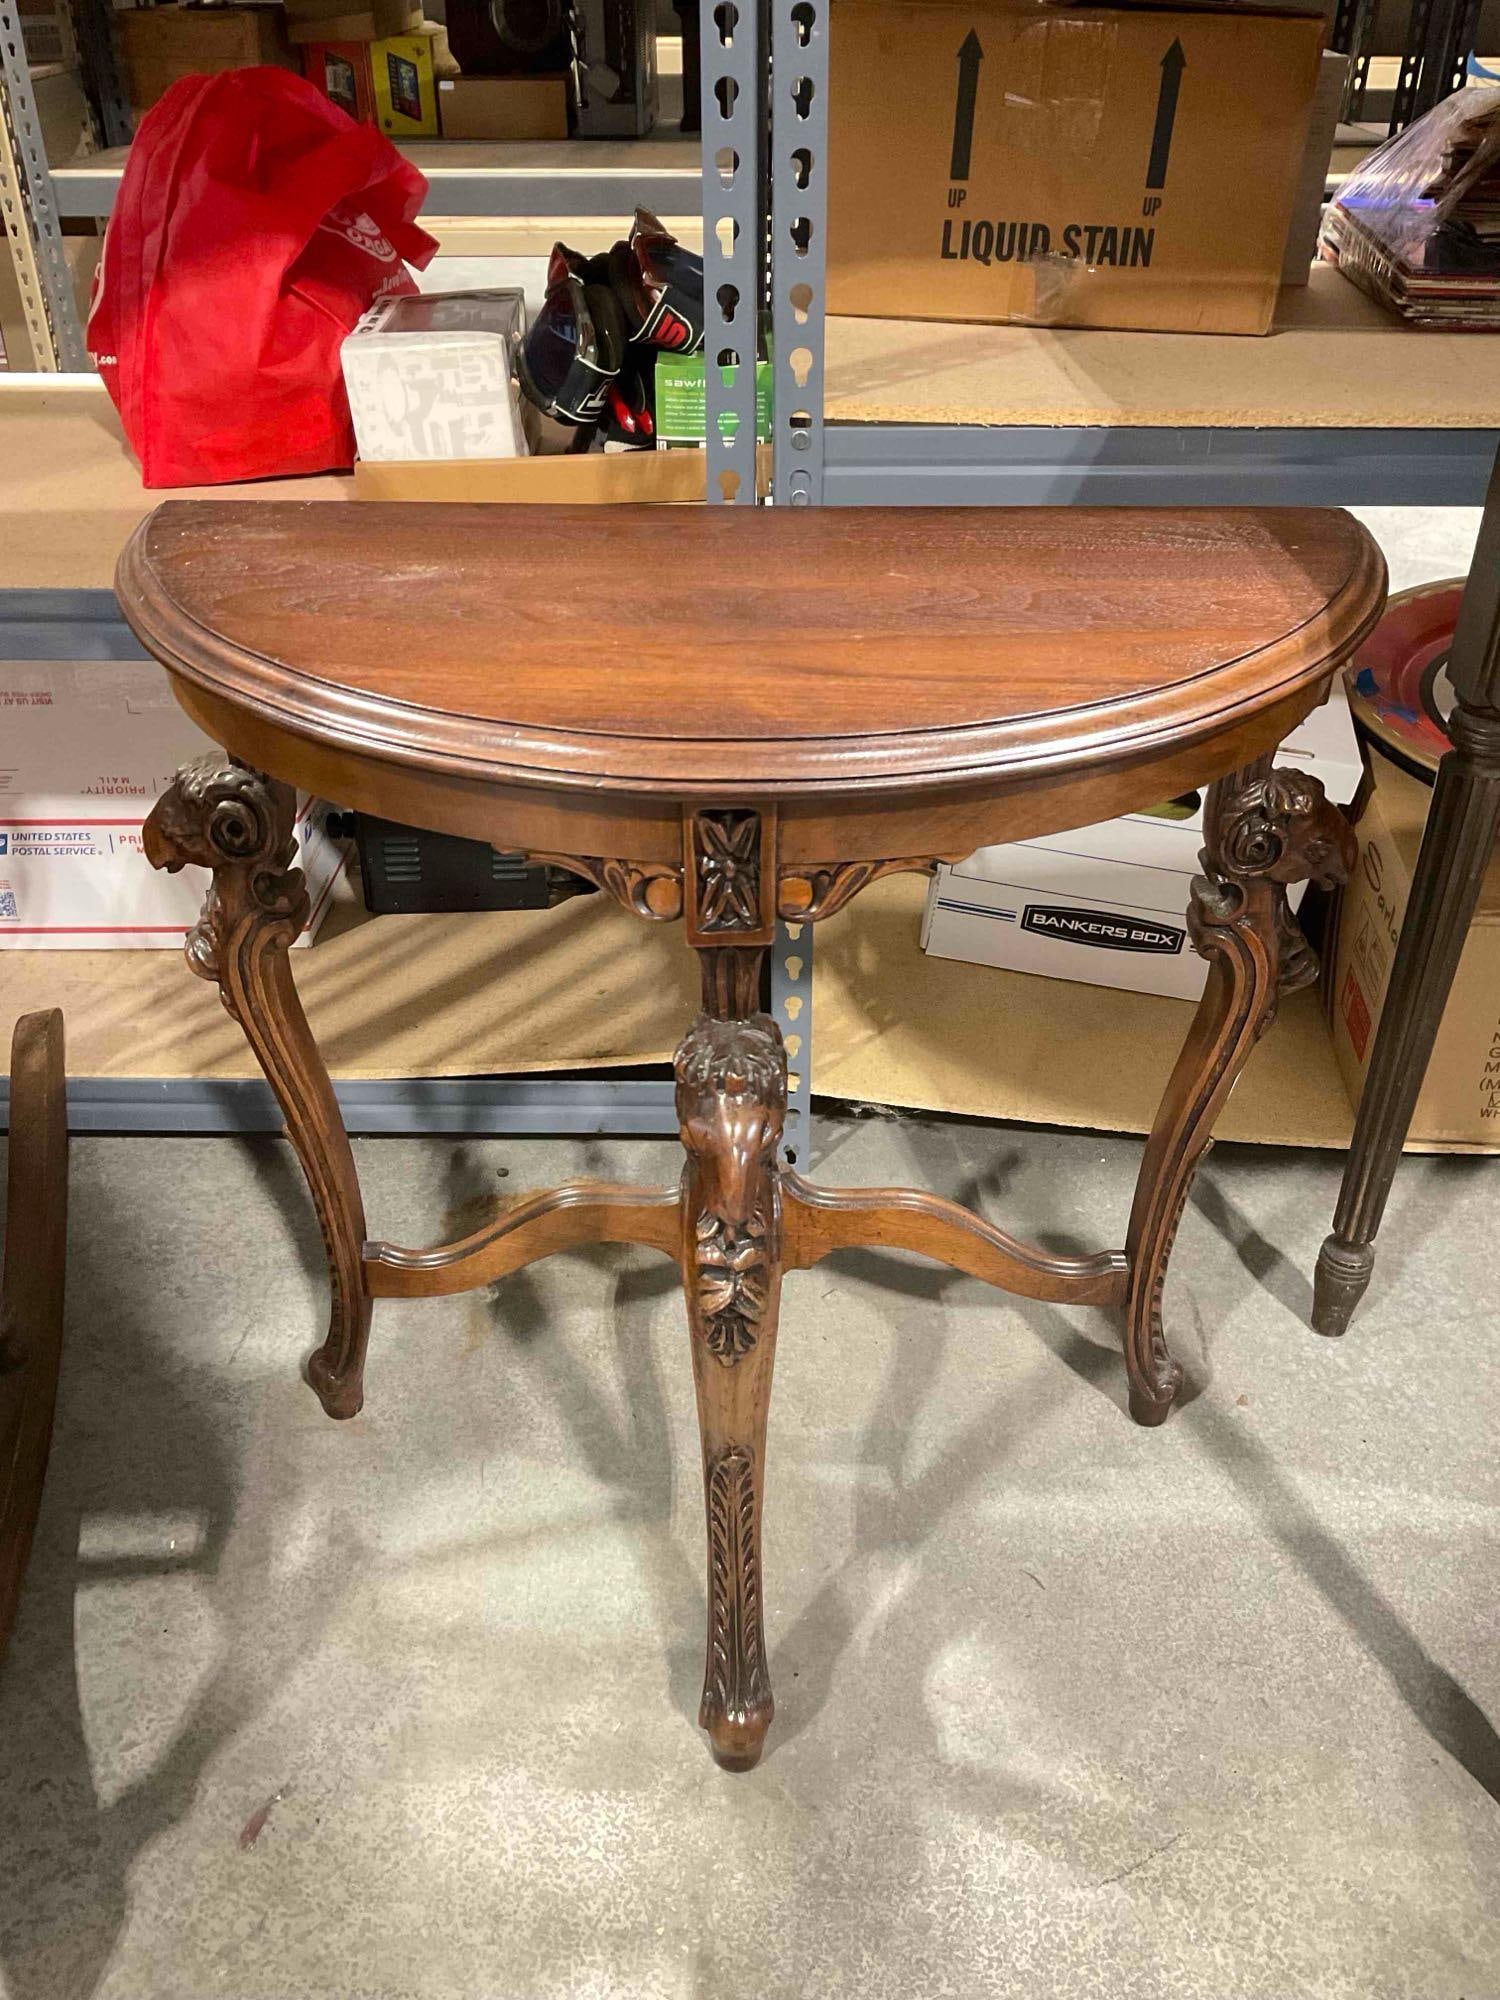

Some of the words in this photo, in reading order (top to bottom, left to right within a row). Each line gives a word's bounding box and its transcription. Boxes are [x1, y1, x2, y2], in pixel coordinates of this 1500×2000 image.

[948, 188, 967, 208] UP
[1142, 196, 1162, 216] UP
[941, 219, 1050, 266] LIQUID
[1062, 224, 1155, 267] STAIN
[99, 776, 130, 784] MAIL
[11, 833, 52, 841] UNITED
[54, 832, 91, 841] STATES
[12, 847, 51, 856] POSTAL
[1032, 913, 1128, 938] BANKERS
[1130, 929, 1176, 946] BOX
